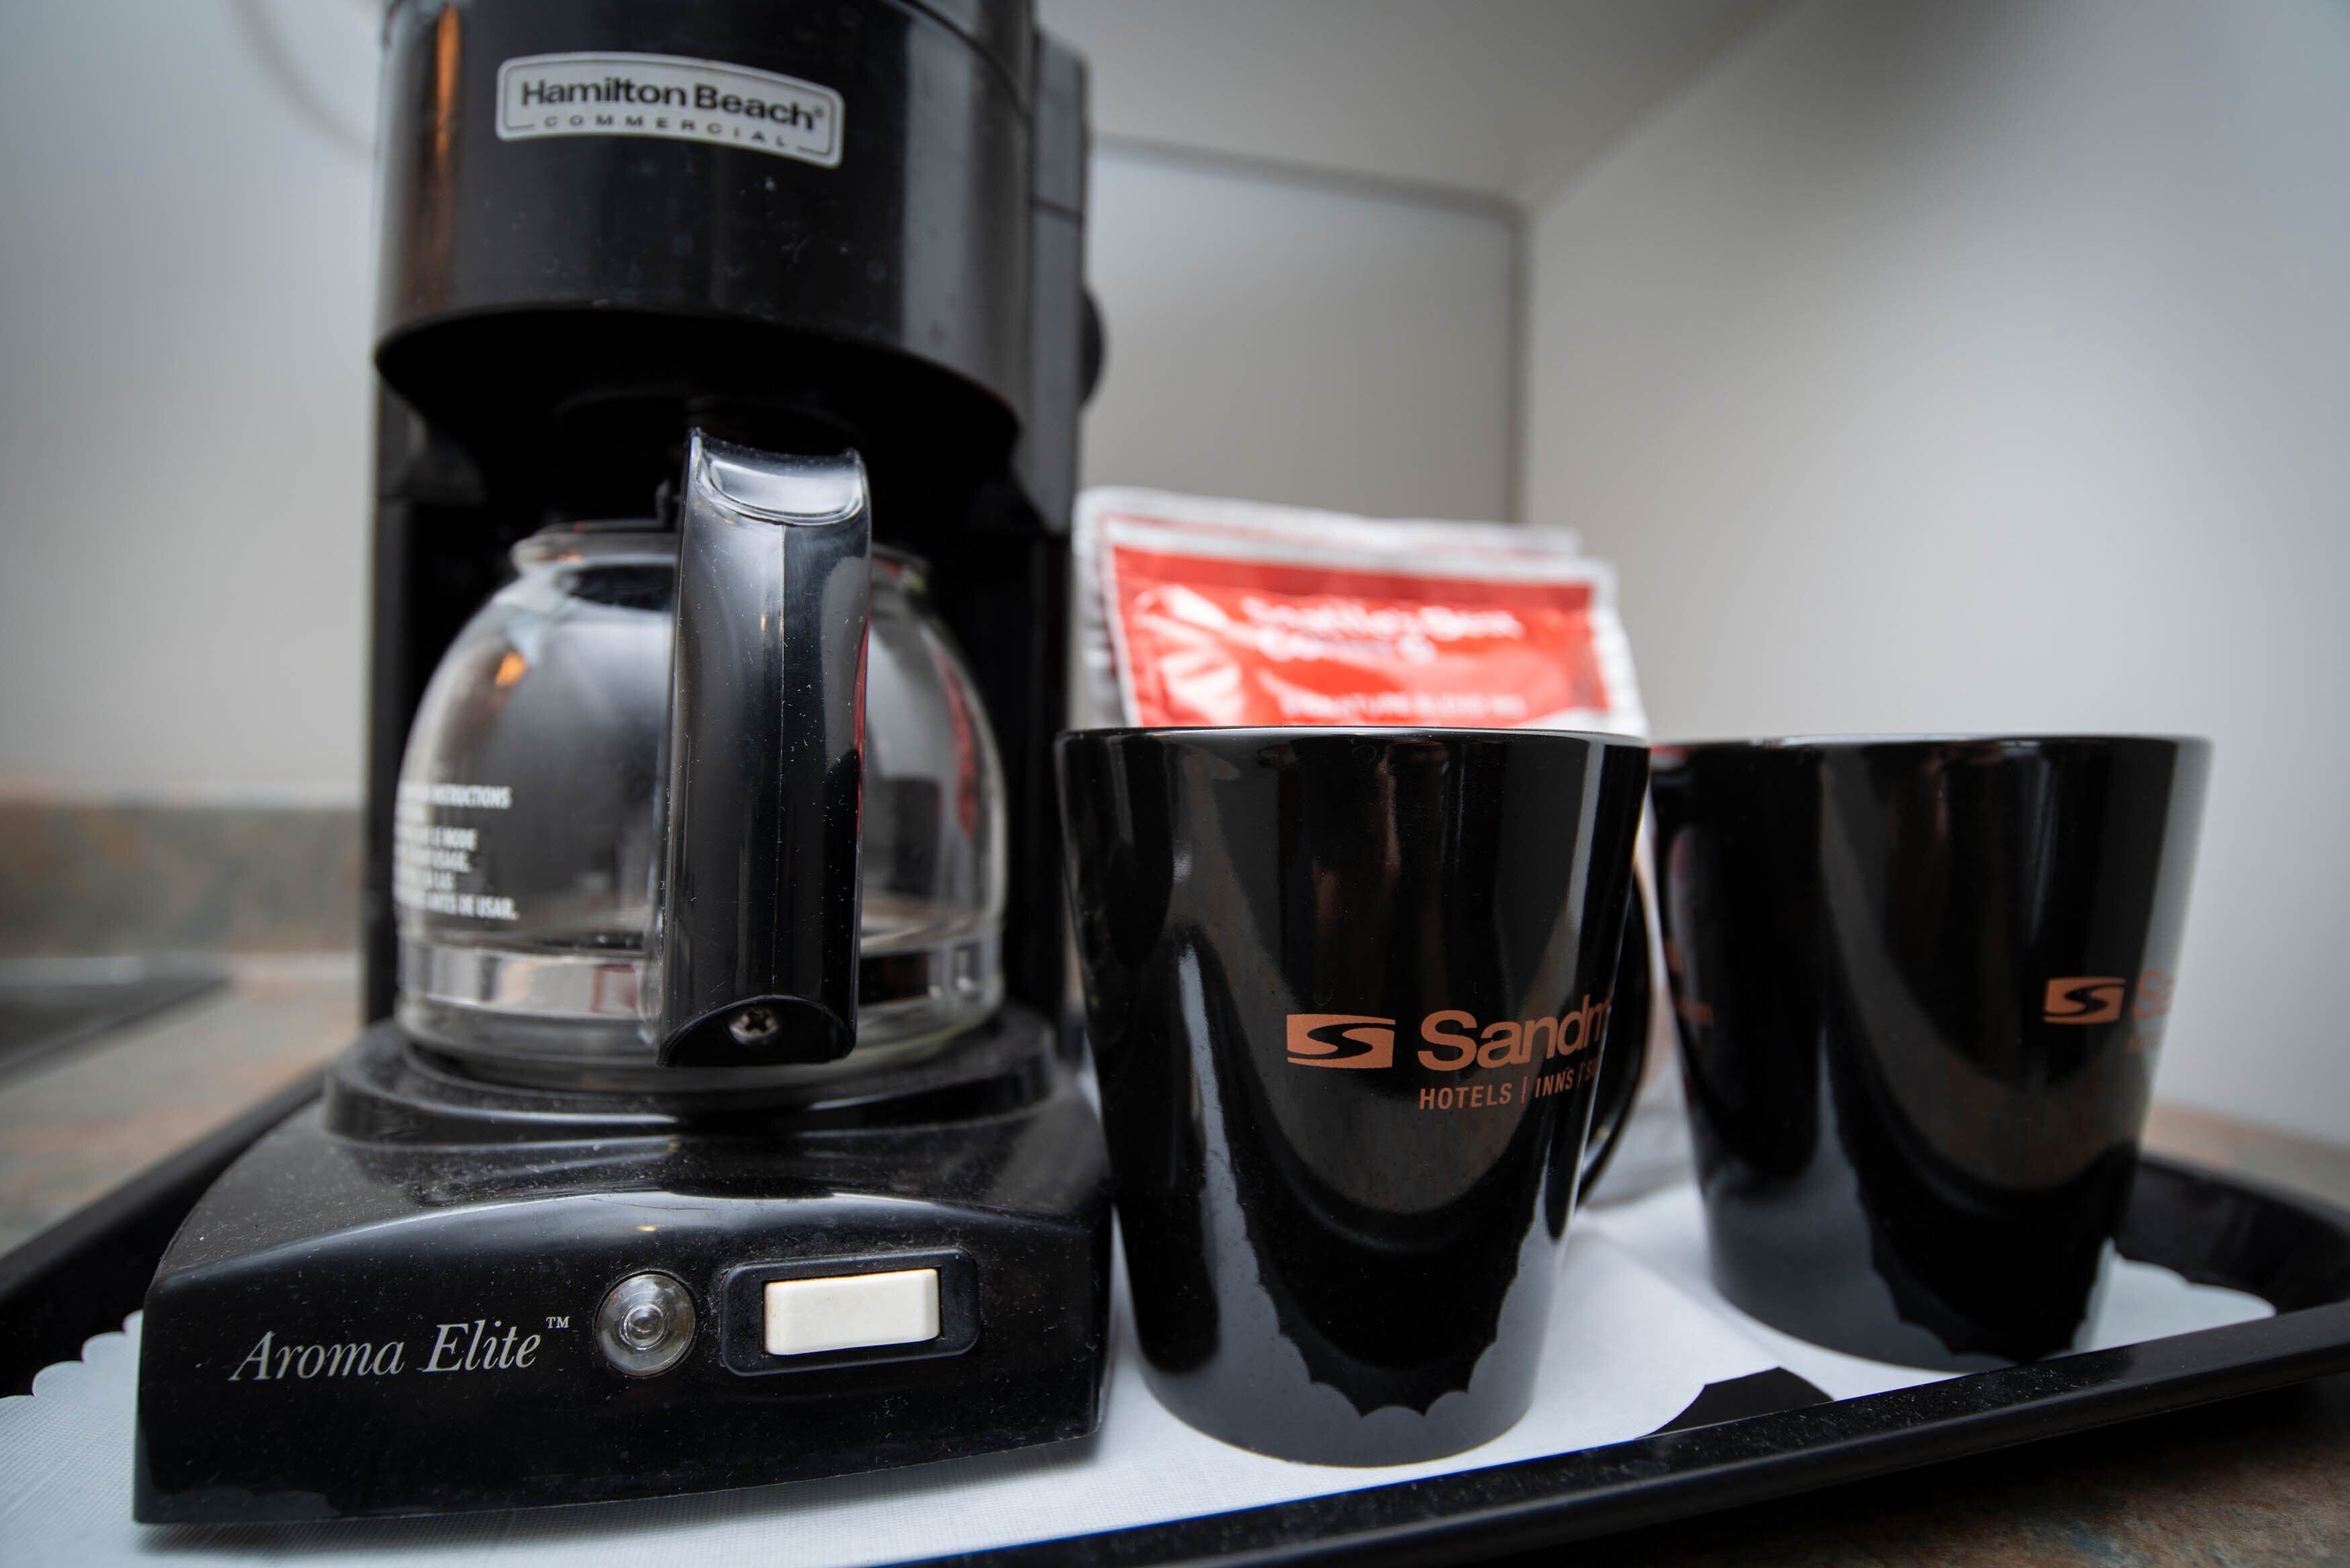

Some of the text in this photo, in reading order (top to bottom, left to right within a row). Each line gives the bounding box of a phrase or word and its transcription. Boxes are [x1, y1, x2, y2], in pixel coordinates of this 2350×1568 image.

[521, 76, 687, 107] Hamilton
[544, 114, 786, 146] COMMERCIAL
[1419, 1081, 1512, 1110] HOTELS
[1535, 1068, 1574, 1099] INNS
[228, 1330, 405, 1381] Aroma
